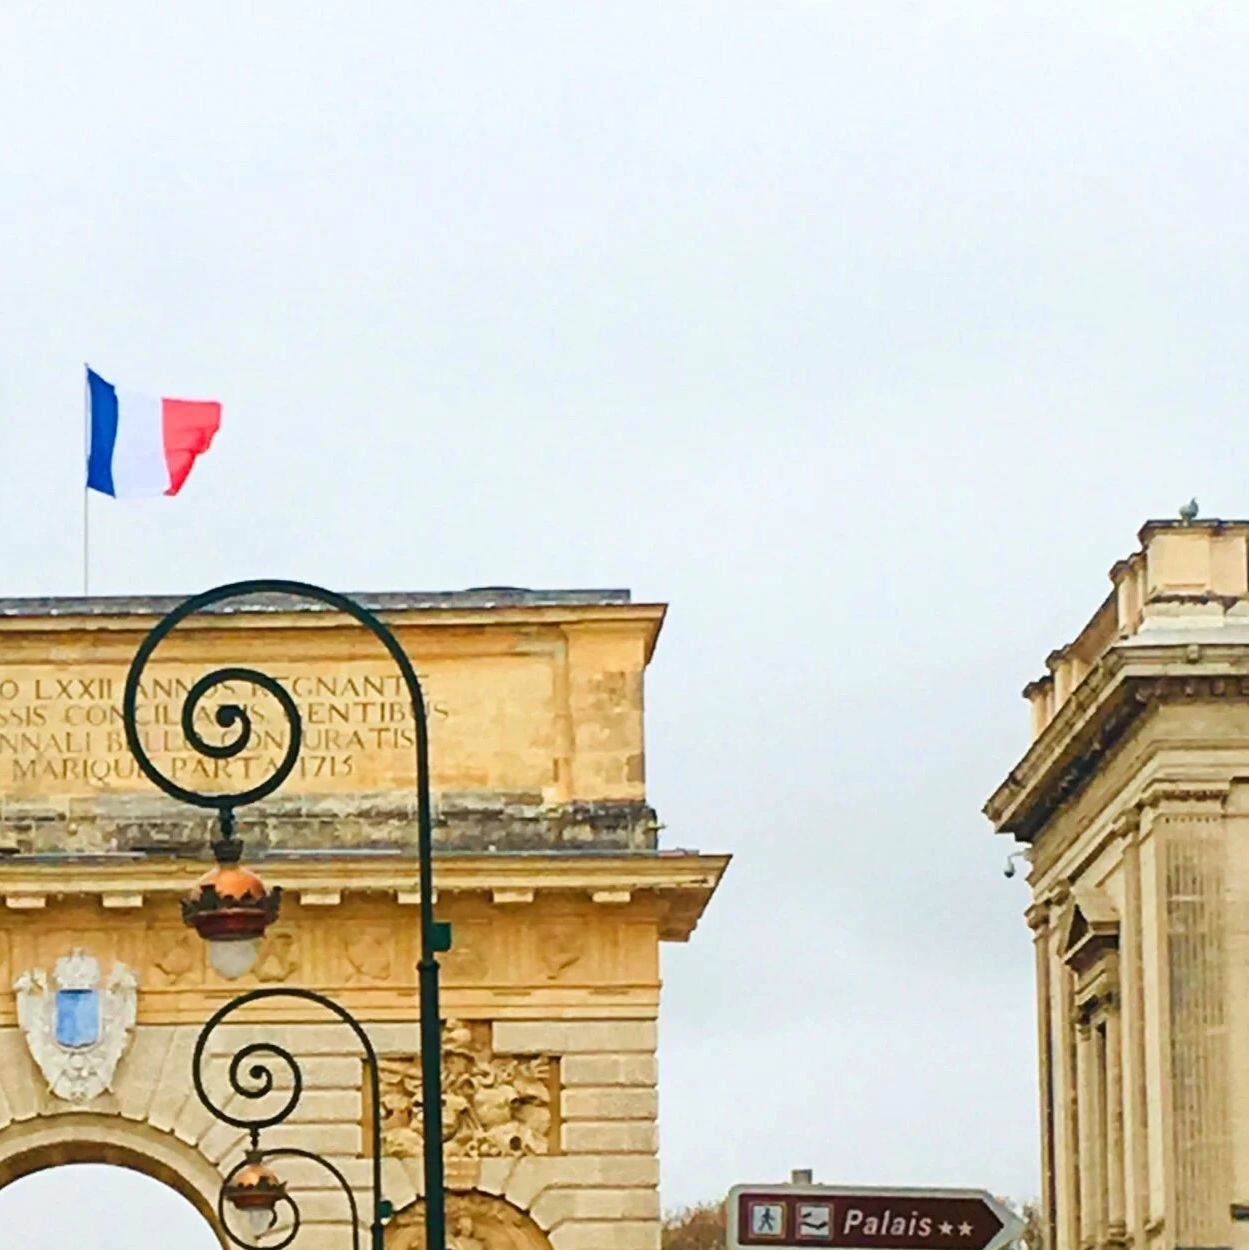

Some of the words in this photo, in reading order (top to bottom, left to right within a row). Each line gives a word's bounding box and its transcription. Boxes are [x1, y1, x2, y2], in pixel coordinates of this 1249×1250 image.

[34, 678, 113, 701] LXXII
[251, 675, 429, 698] RGNANT
[63, 703, 265, 727] CONCILAS
[284, 701, 449, 724] ENTIBS
[106, 730, 195, 753] BLL
[220, 727, 415, 752] CONURATIS
[170, 757, 280, 779] PARTA
[300, 754, 354, 779] 1715
[842, 1208, 933, 1237] Palais
